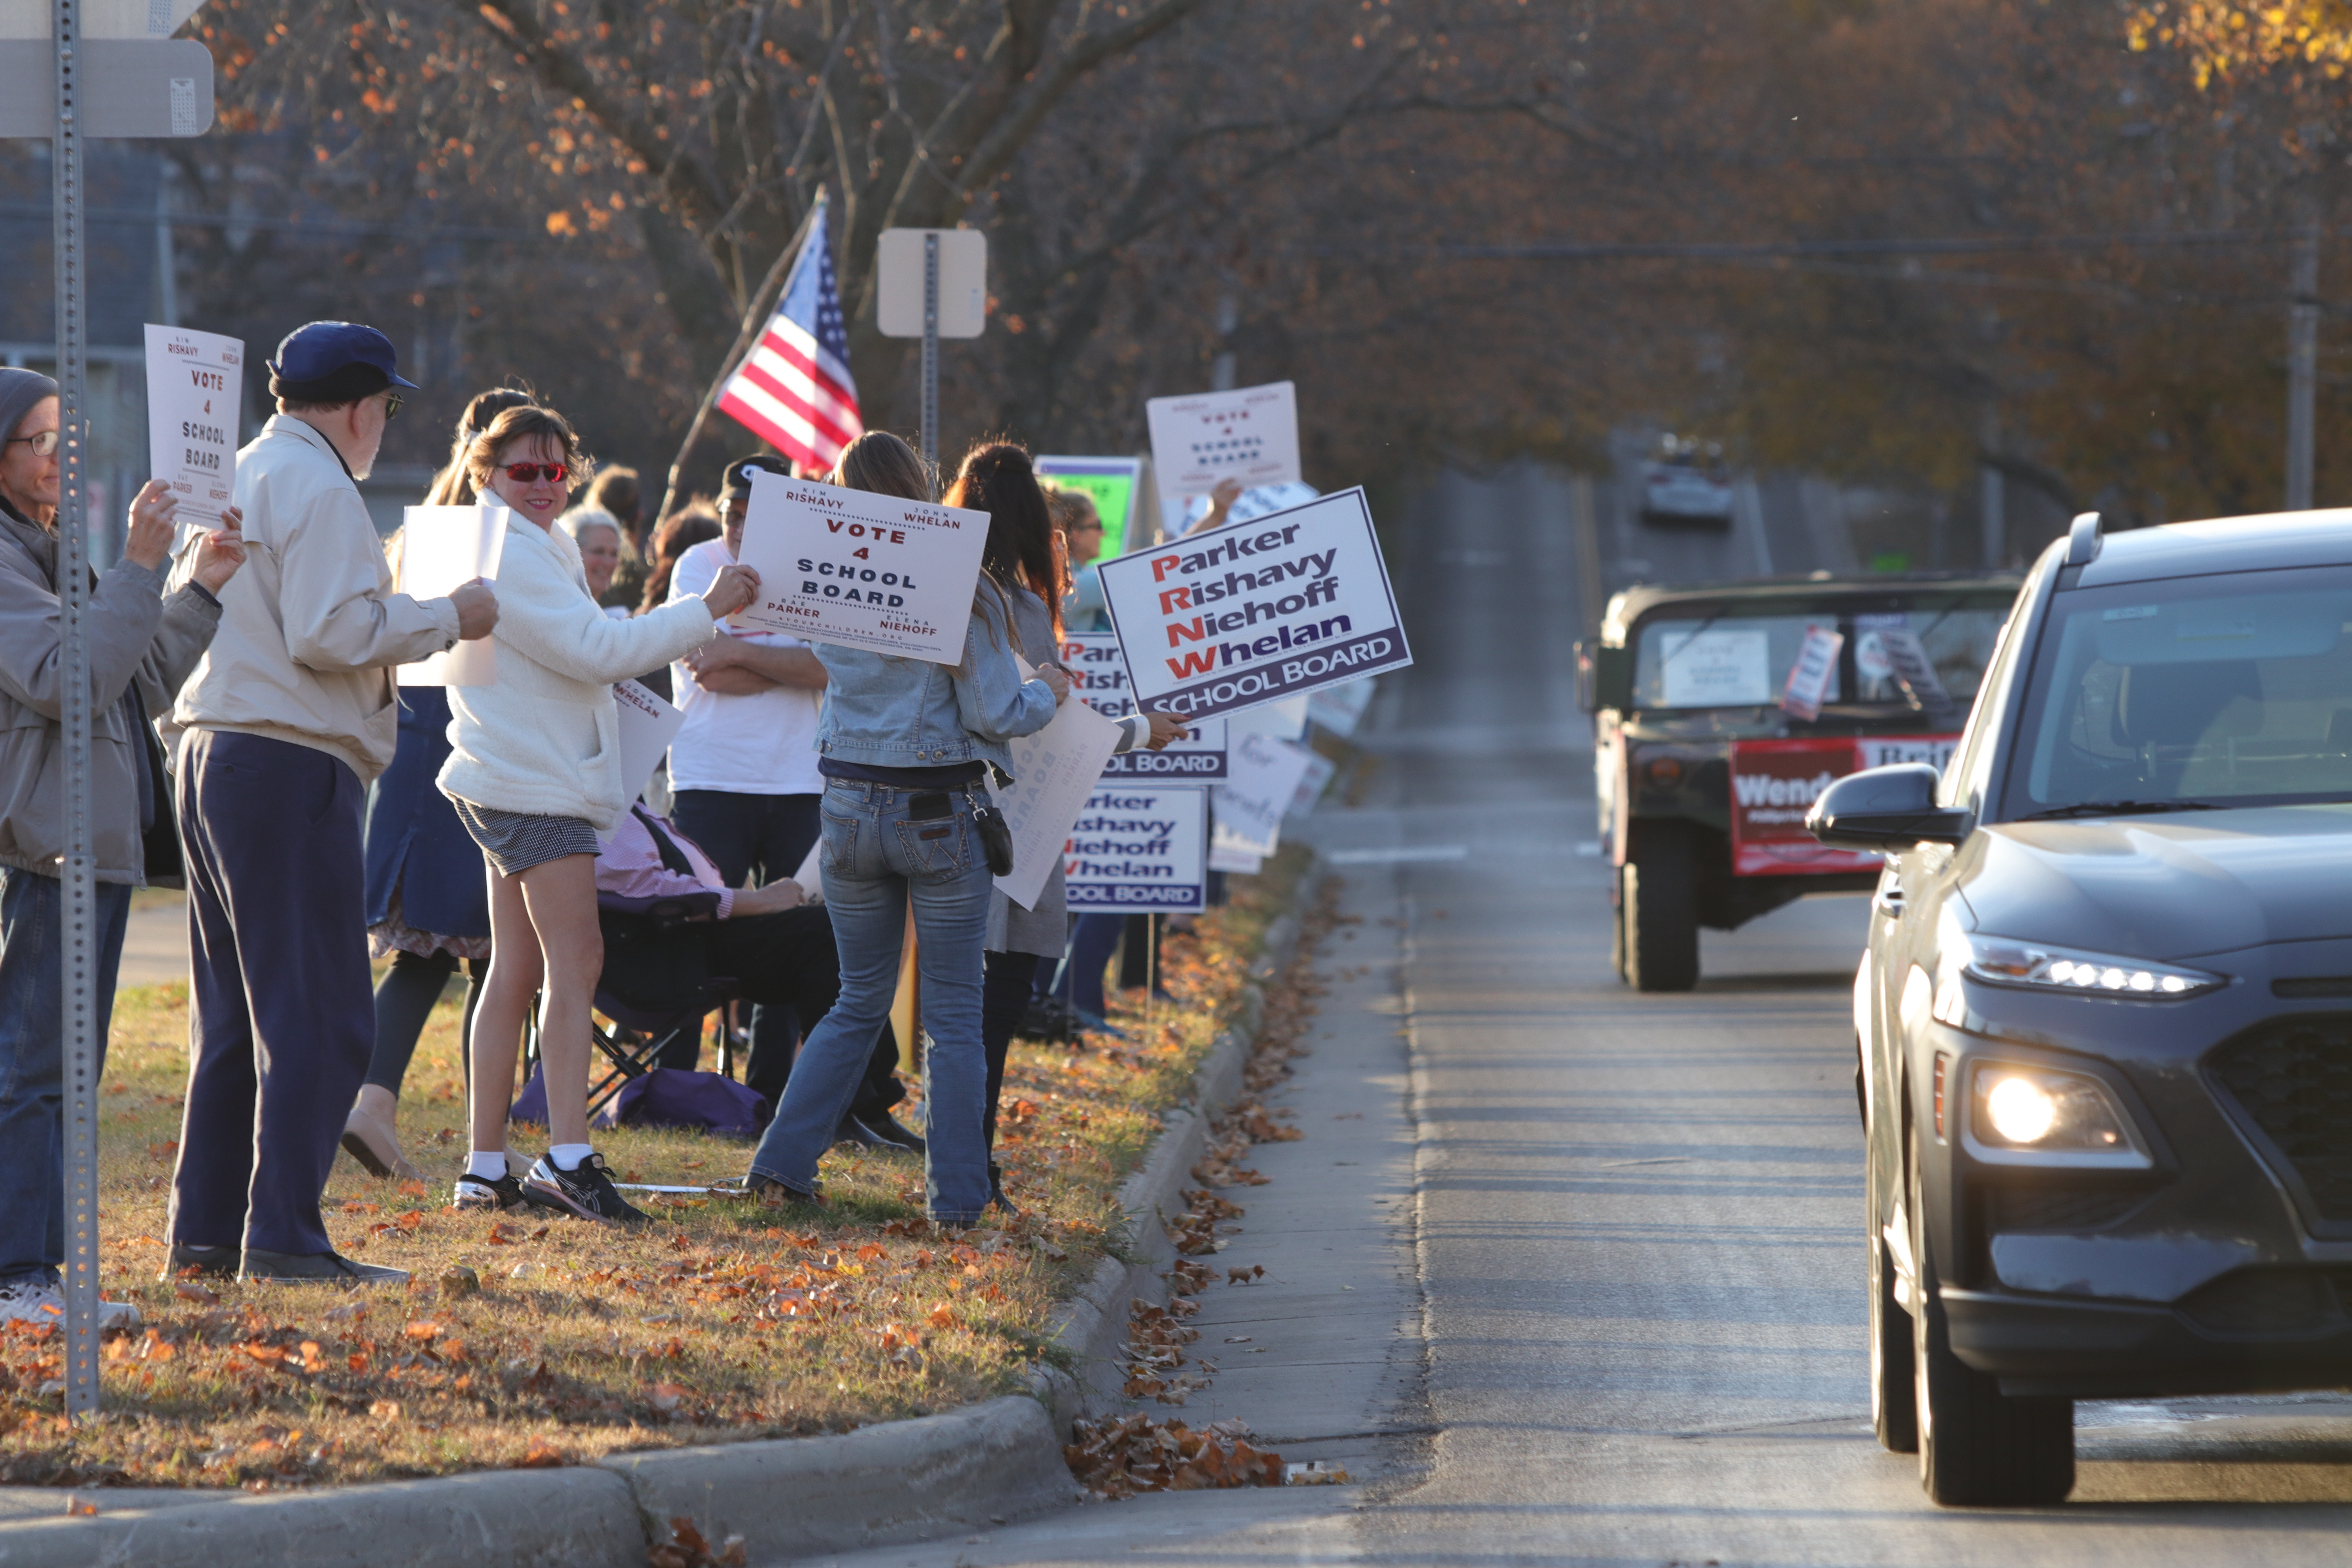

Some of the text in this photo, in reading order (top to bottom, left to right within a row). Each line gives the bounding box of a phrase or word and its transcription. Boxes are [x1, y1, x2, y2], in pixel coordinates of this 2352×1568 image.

[168, 343, 198, 357] RISHAVY
[191, 370, 223, 392] VOTE
[203, 399, 211, 415] 4
[182, 421, 225, 445] SCHOOL
[185, 448, 220, 470] BOARD
[787, 492, 844, 509] RISHAVY
[803, 488, 826, 496] KIM
[904, 513, 960, 529] WHELAN
[915, 508, 948, 517] JOHN
[827, 519, 905, 544] VOTE
[853, 547, 869, 560] 4
[1151, 524, 1300, 583] Parker
[798, 559, 916, 589] SCHOOL
[1159, 548, 1337, 615] Rishavy
[802, 581, 903, 607] BOARD
[768, 603, 819, 618] PARKER
[887, 615, 928, 626] ELENA
[1166, 576, 1338, 648] Niehoff
[880, 621, 936, 635] NIEHOFF
[1063, 642, 1122, 662] Par
[1166, 615, 1352, 679] Whelan
[1064, 670, 1131, 689] Rish
[1153, 672, 1280, 715] SCHOOL
[1282, 637, 1392, 684] BOARD
[615, 686, 661, 719] WHELAN
[1136, 754, 1220, 772] BOARD
[1734, 770, 1835, 807] Wend
[1084, 793, 1157, 810] rker
[1073, 816, 1176, 840] shavy
[1065, 885, 1195, 903] OOL BOARD
